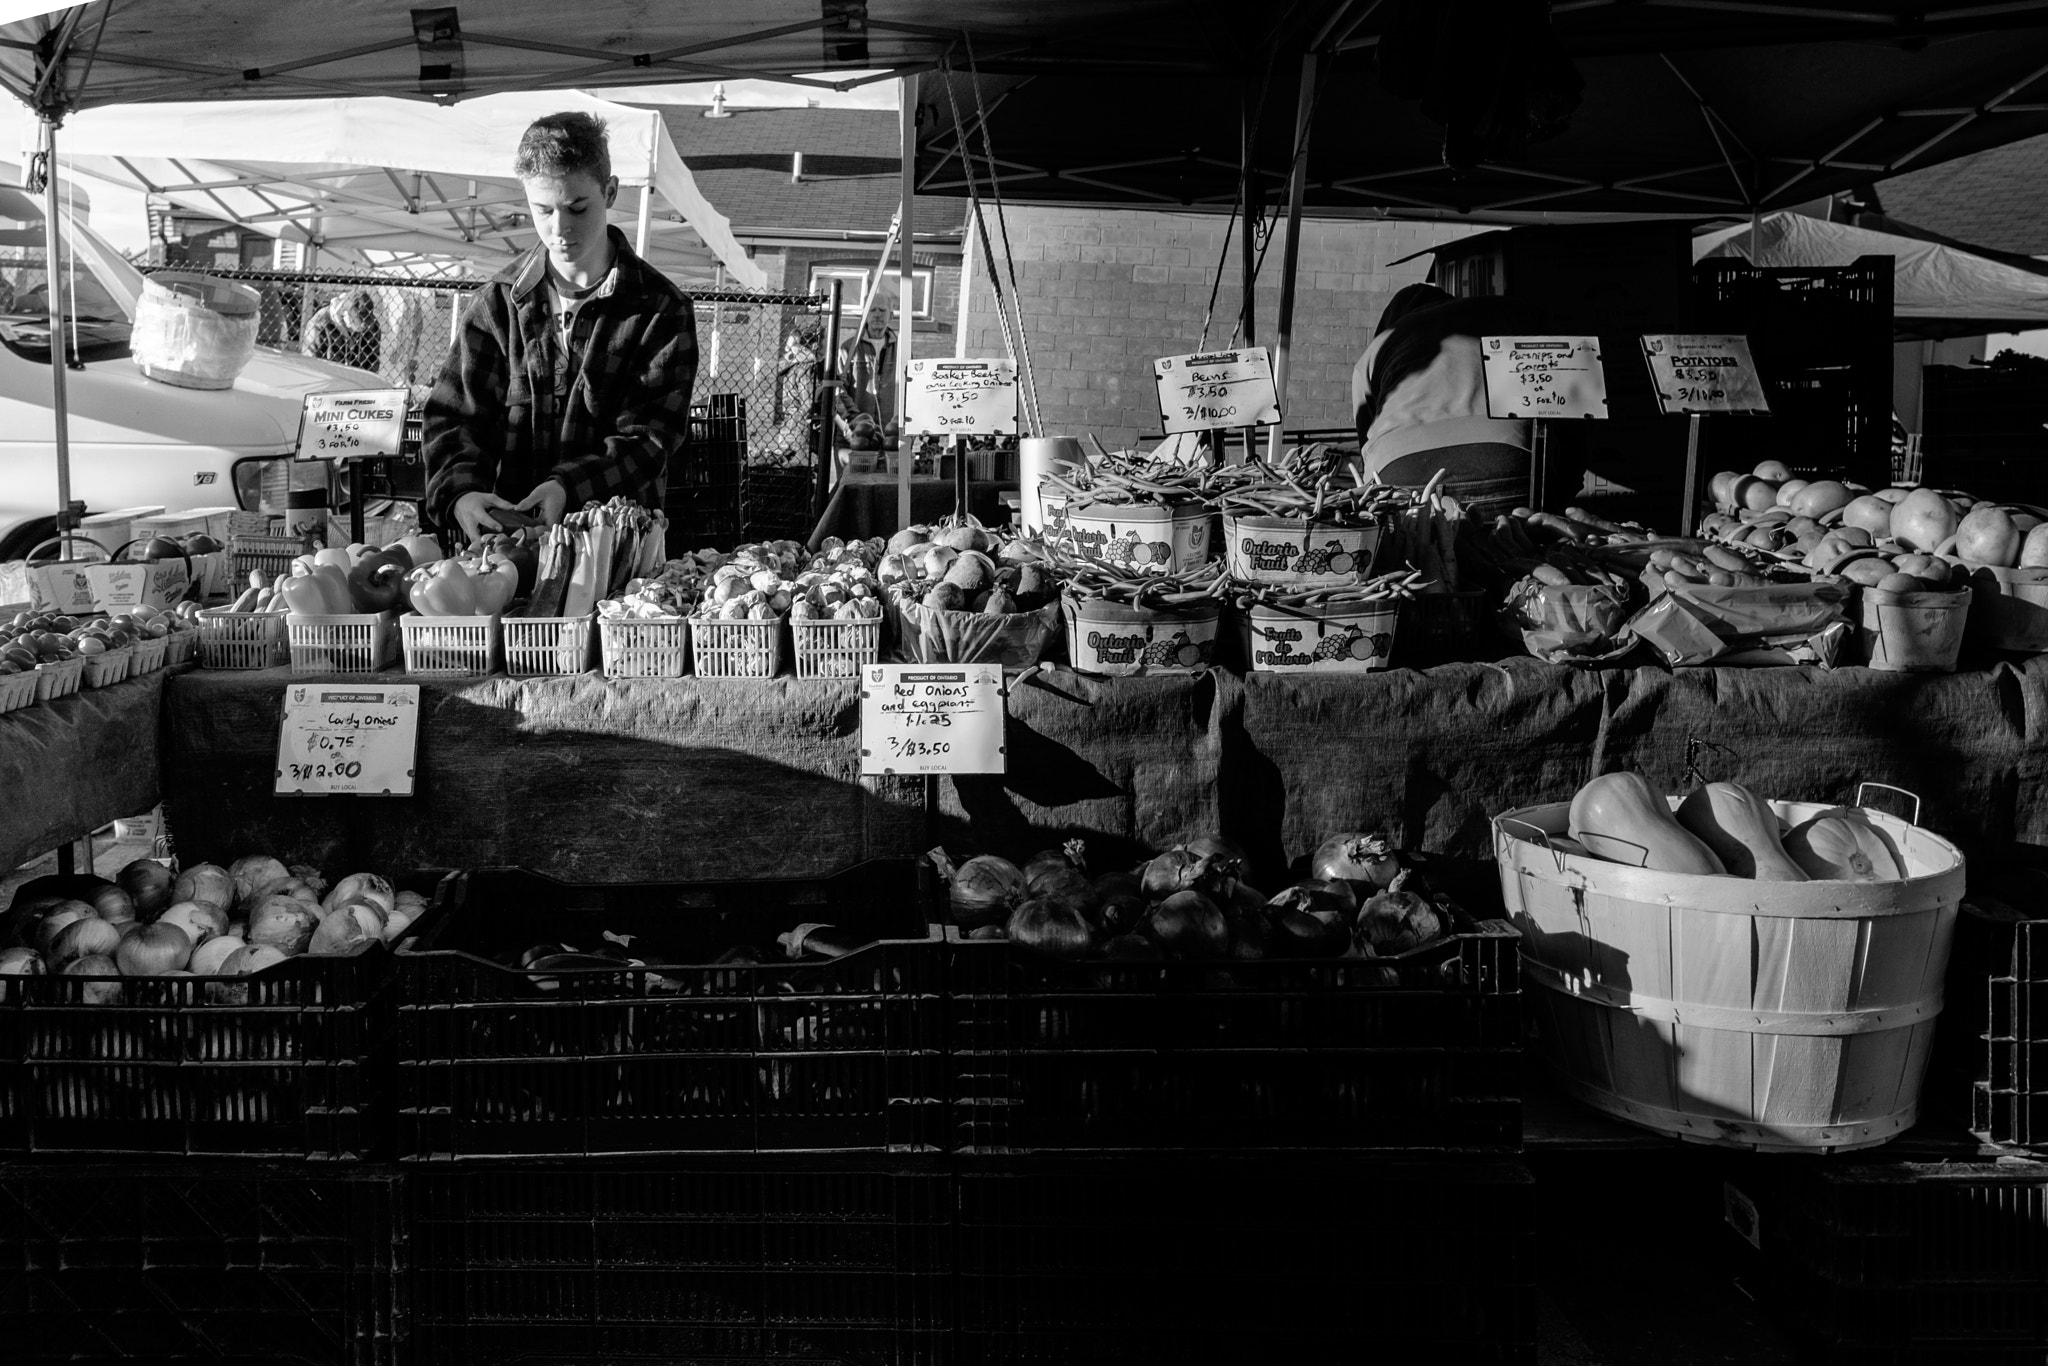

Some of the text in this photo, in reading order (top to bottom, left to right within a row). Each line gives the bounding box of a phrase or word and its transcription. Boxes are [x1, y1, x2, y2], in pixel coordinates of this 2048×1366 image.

[1509, 348, 1574, 362] Parsnips and
[1671, 356, 1738, 367] POTATOES
[932, 368, 1001, 381] Basket Beets
[1192, 371, 1229, 382] Beans
[1520, 373, 1553, 385] $3.50
[1675, 369, 1717, 381] $3.50
[1522, 396, 1531, 406] 3
[1551, 391, 1566, 405] $10
[314, 409, 394, 422] MINI CUKES
[938, 415, 948, 425] 3
[965, 415, 975, 425] 10
[318, 439, 326, 449] 3
[194, 474, 214, 486] V8
[1242, 538, 1299, 557] Ontario
[1250, 555, 1288, 571] Fruit
[1087, 631, 1146, 649] Ontario
[1264, 627, 1302, 641] Fruits
[1275, 640, 1292, 653] de
[1097, 648, 1135, 664] Fruit
[1256, 650, 1312, 665] l'Ontario
[894, 684, 916, 697] Red
[925, 685, 969, 697] Onions
[882, 698, 976, 712] and eggplant
[307, 732, 355, 752] $0.75
[887, 737, 951, 757] 3/$3.50
